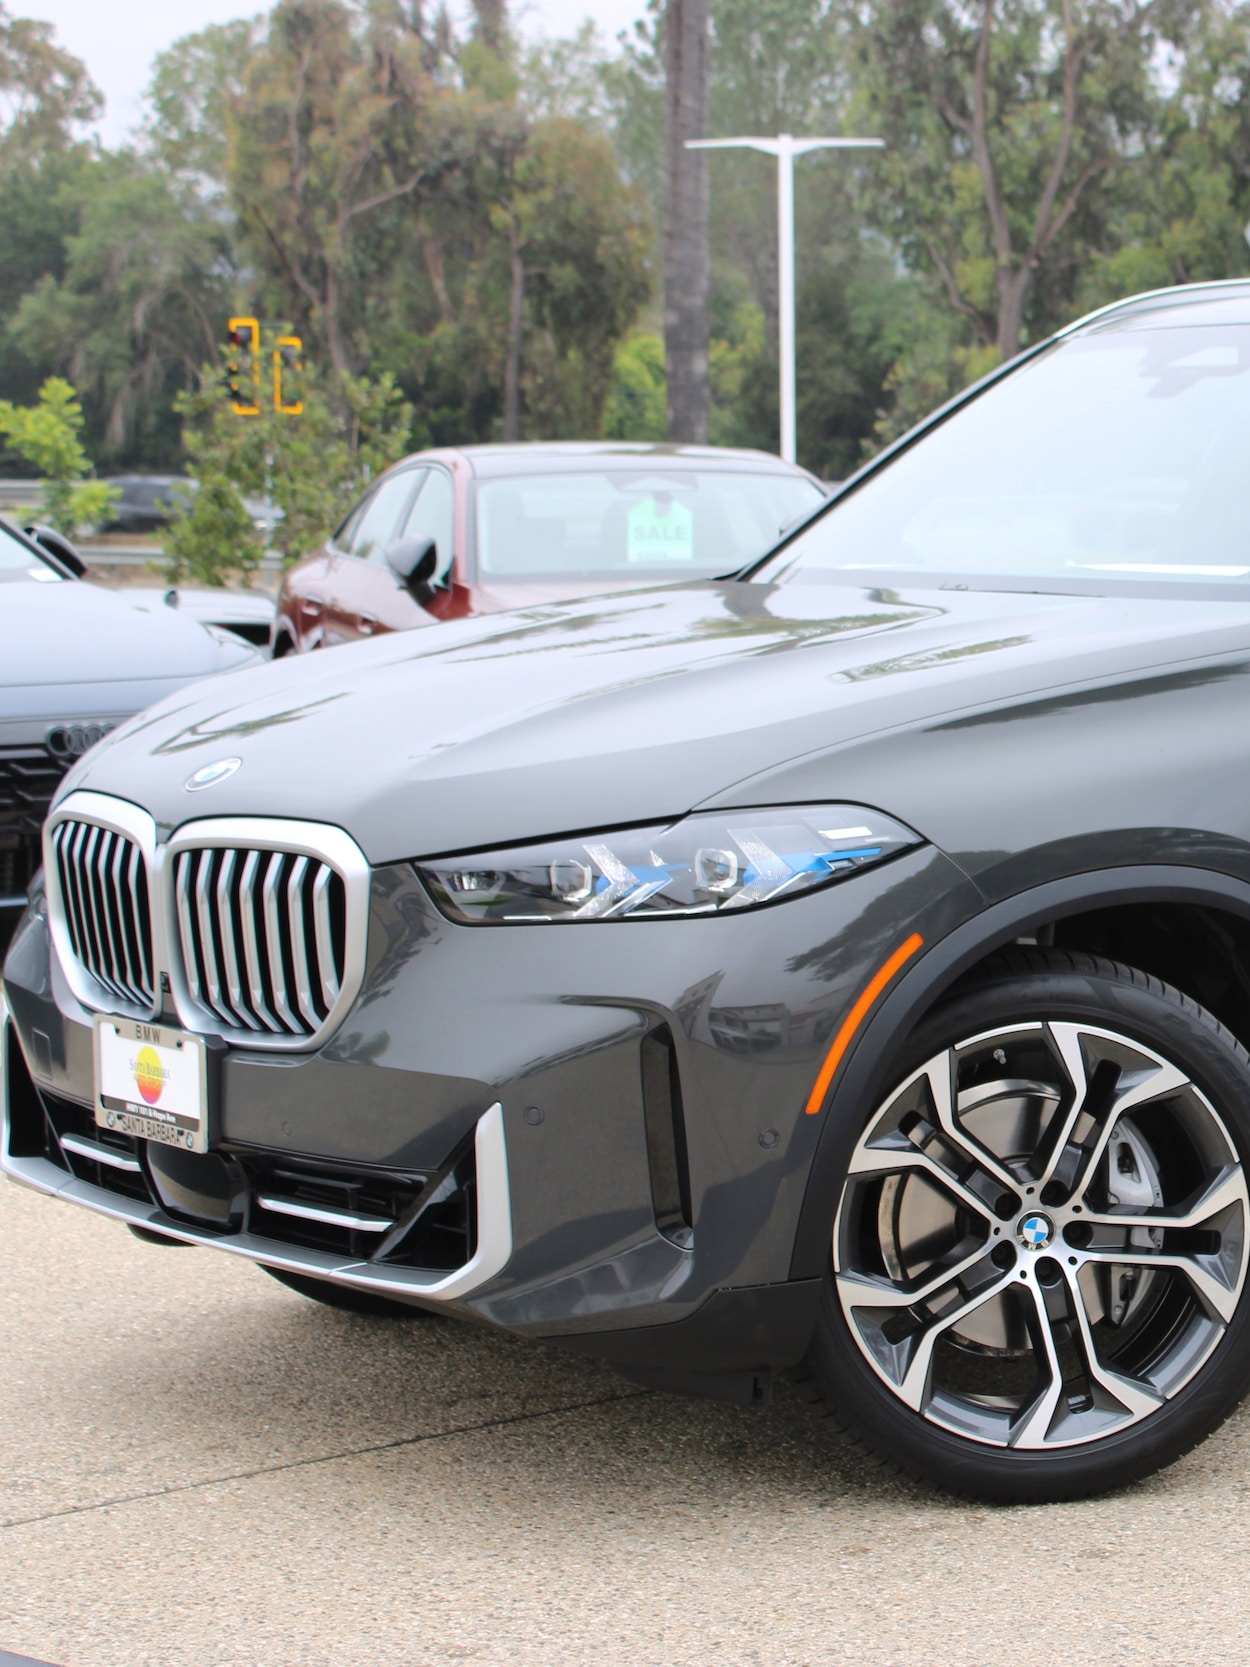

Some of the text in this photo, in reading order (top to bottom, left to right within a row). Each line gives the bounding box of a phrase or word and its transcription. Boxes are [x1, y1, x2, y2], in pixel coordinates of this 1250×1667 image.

[633, 525, 688, 541] SALE
[136, 1024, 160, 1043] BMW
[122, 1115, 181, 1145] SANTA BARBARA
[1016, 1234, 1050, 1250] BMW
